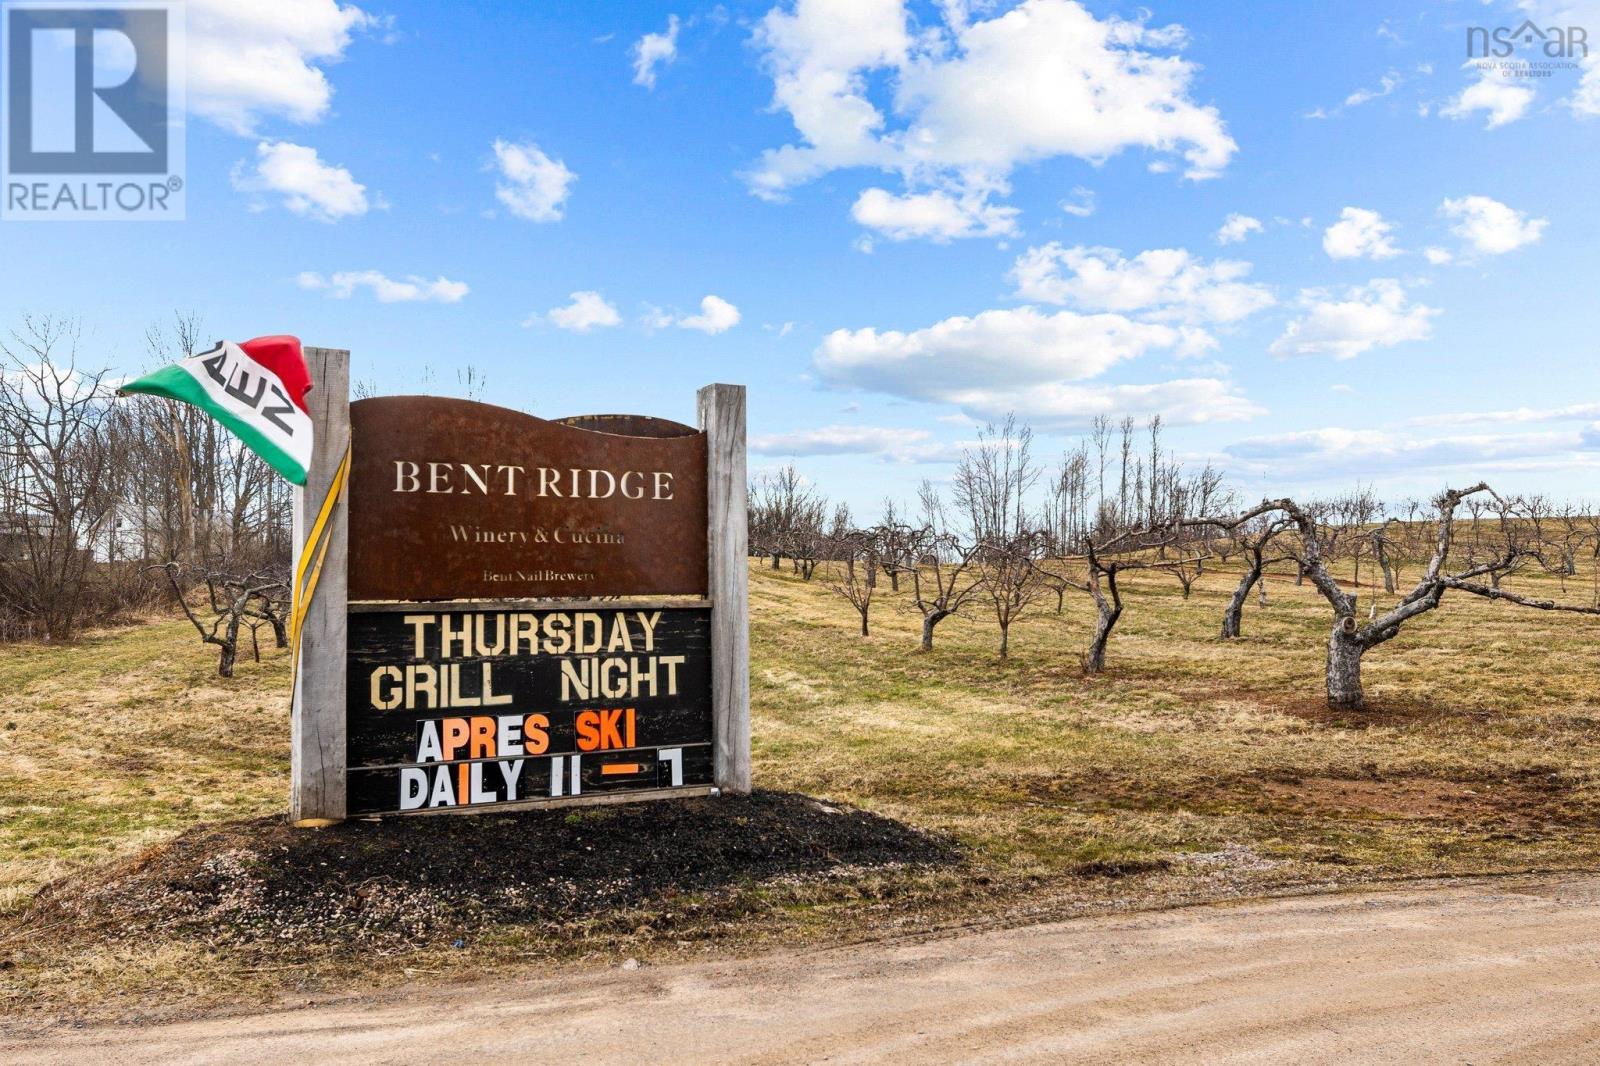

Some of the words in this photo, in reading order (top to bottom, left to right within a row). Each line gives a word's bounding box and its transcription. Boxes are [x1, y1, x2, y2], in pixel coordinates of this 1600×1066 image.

[190, 340, 296, 437] PEN
[392, 460, 526, 497] BENT
[537, 466, 675, 500] RIDGE
[533, 527, 549, 544] &
[553, 526, 625, 545] Cucina
[483, 570, 513, 582] Bent
[515, 570, 543, 582] Nail
[403, 610, 662, 659] THURSDAY
[370, 662, 513, 710] GRILL
[561, 655, 686, 701] NIGHT
[416, 712, 550, 763] APRES
[575, 708, 636, 752] SKI
[400, 758, 525, 810] DAILY
[657, 747, 684, 787] 7
